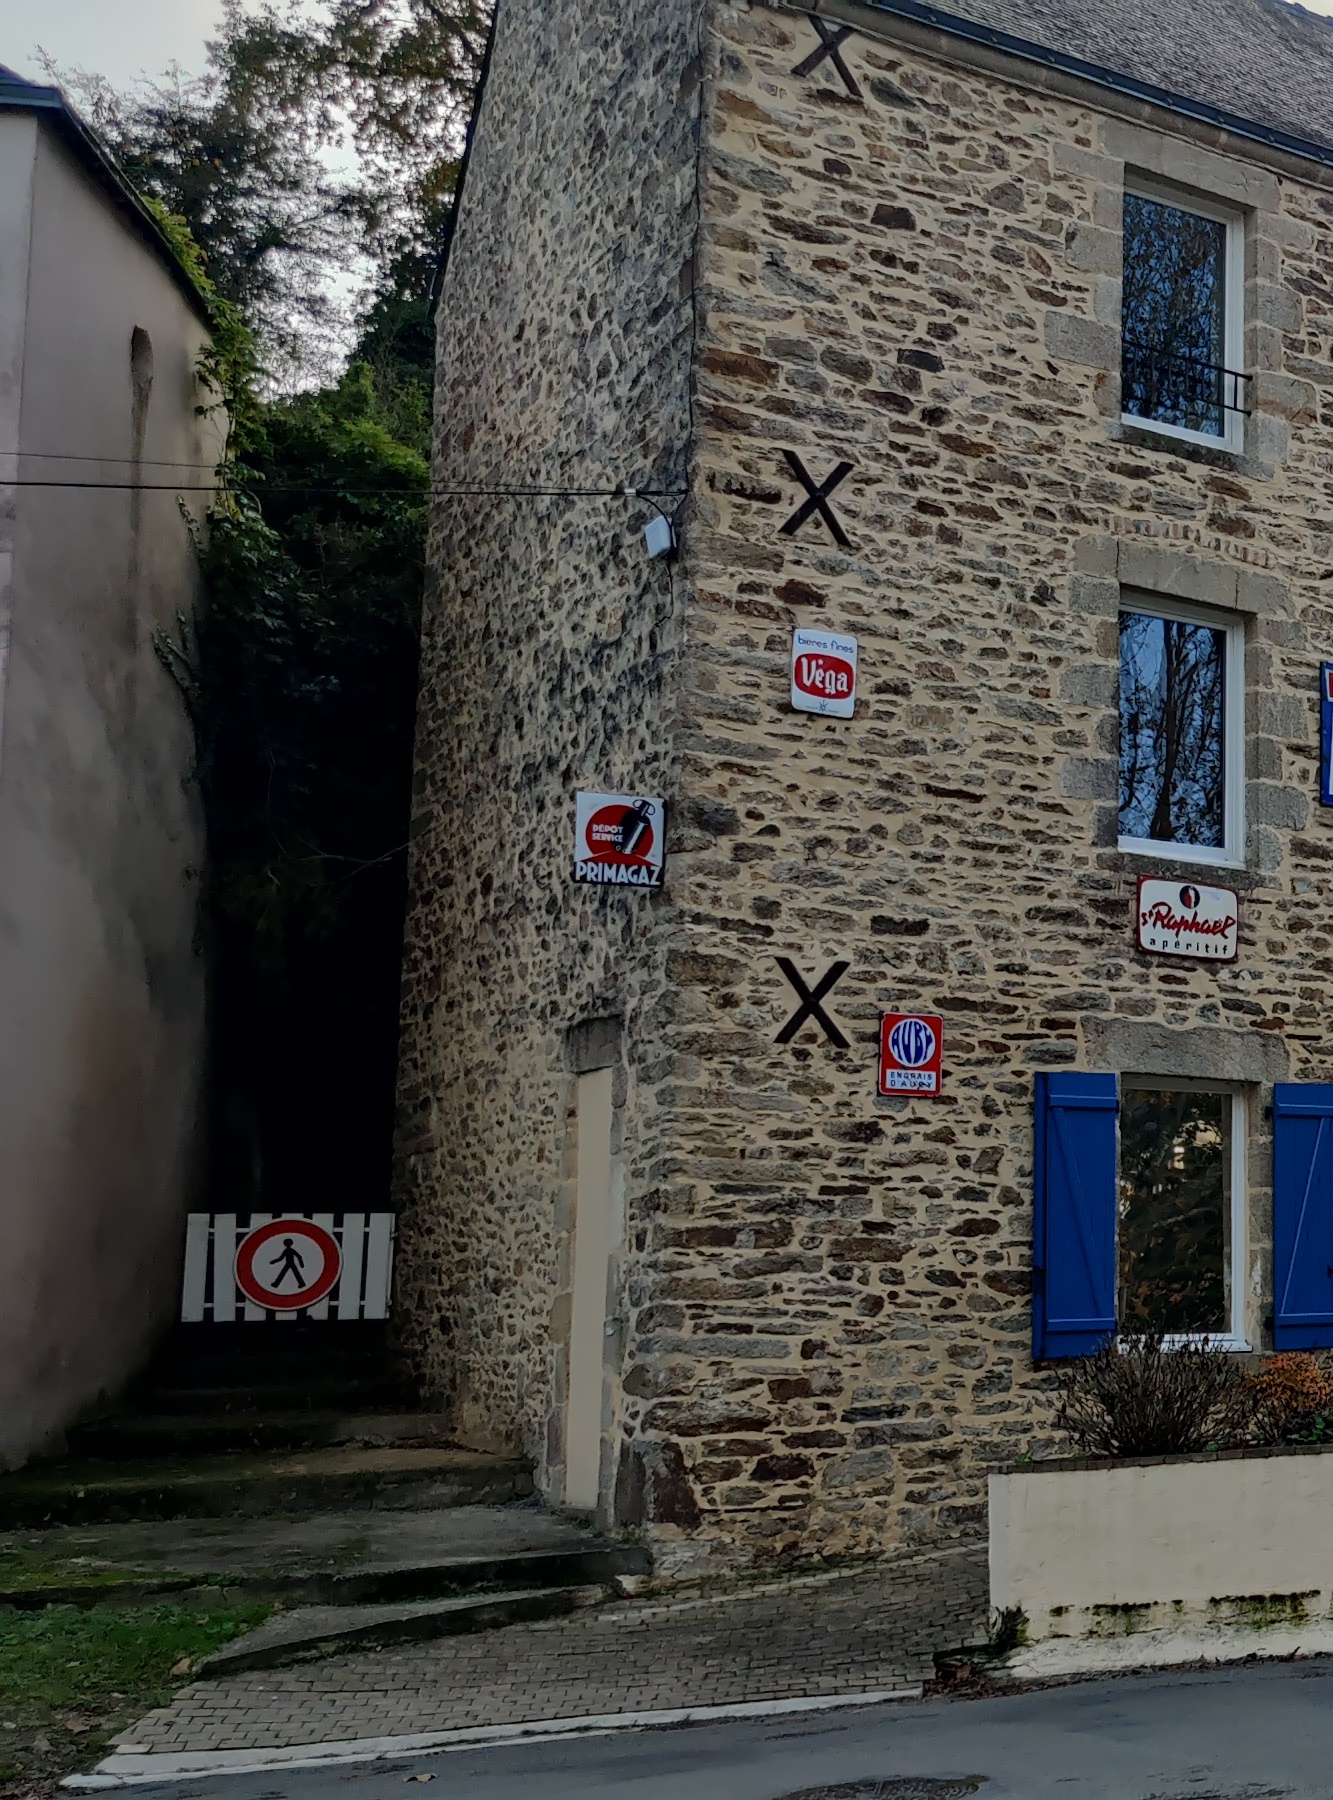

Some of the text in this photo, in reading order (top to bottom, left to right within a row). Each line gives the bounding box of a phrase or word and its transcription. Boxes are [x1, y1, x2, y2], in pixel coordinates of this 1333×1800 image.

[831, 640, 854, 654] fines
[592, 832, 624, 842] SERVICE
[575, 861, 661, 886] PRIMAGAZ
[1150, 938, 1228, 954] apéritif
[891, 1020, 934, 1064] AUBY
[890, 1072, 933, 1080] ENGRAIS
